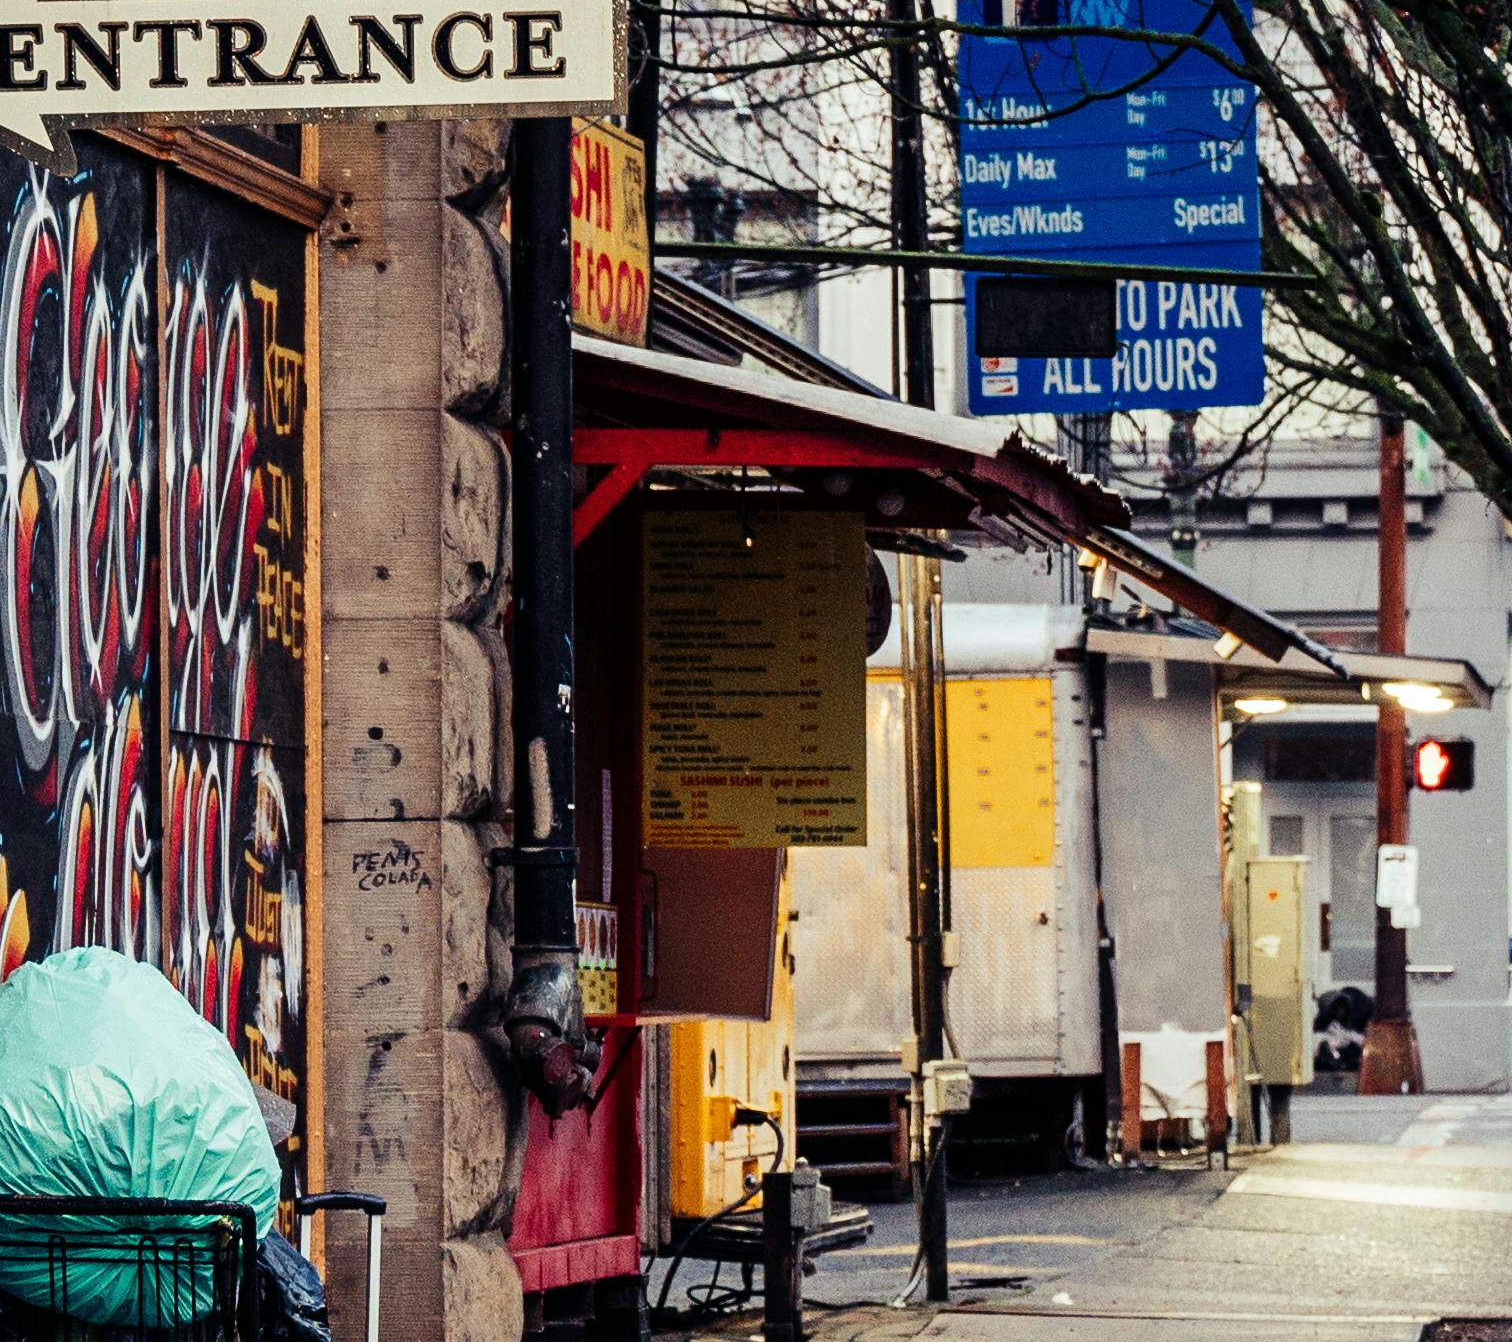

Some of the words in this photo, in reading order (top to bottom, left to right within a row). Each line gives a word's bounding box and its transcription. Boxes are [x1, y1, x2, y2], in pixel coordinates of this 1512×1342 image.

[964, 154, 1011, 188] Daily
[1016, 152, 1057, 181] Max
[966, 204, 1084, 238] Eves/Wknds
[1173, 195, 1246, 233] Special
[1157, 280, 1243, 330] PARK
[1043, 356, 1102, 395] ALL
[1111, 337, 1218, 393] HOURS
